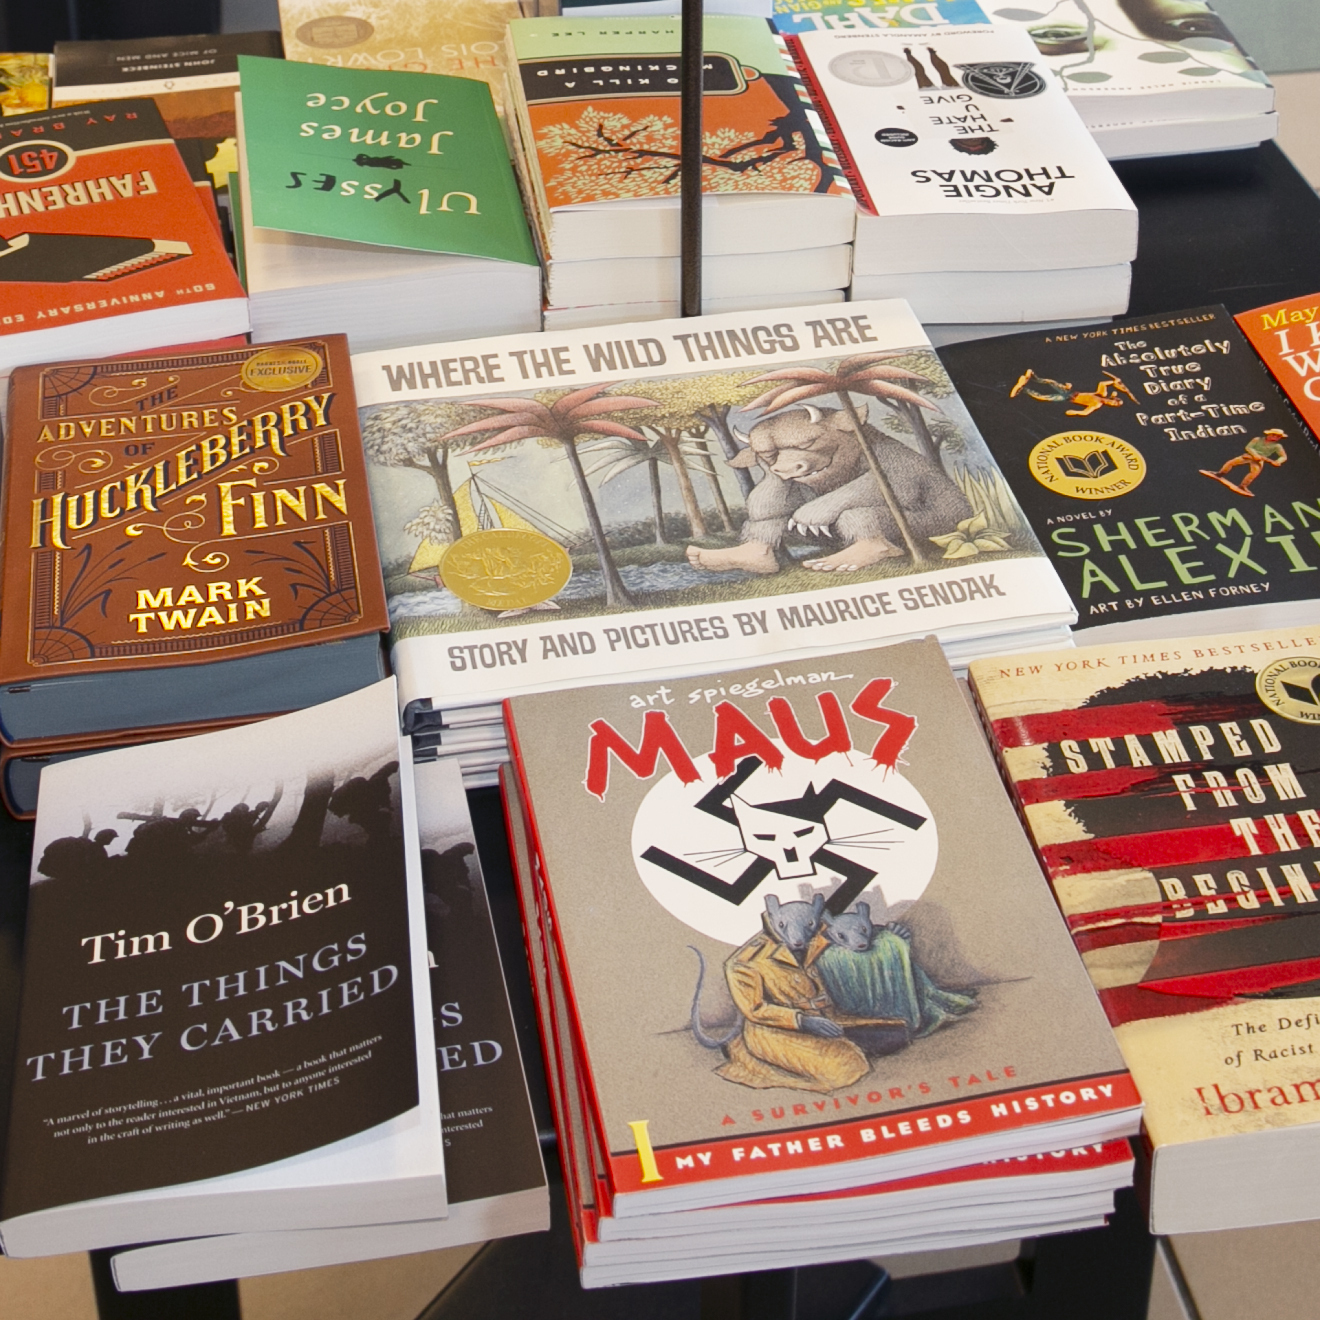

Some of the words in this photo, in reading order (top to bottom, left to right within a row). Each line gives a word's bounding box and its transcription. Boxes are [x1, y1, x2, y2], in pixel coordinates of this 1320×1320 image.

[792, 3, 950, 31] DAHL
[599, 29, 675, 37] HARPER
[122, 62, 181, 73] STEINBECK
[592, 78, 650, 87] KILL
[305, 91, 439, 122] Joyce
[920, 93, 973, 105] GIVE
[85, 111, 138, 126] RAY
[929, 113, 988, 126] HATE
[953, 123, 1000, 135] THE
[299, 122, 454, 155] James
[7, 149, 59, 175] 451
[910, 165, 1076, 184] THOMAS
[939, 181, 1056, 199] ANGIE
[36, 290, 165, 320] ANNIVERSARY
[1055, 332, 1079, 343] NEW
[1082, 327, 1109, 339] YORK
[1111, 323, 1147, 336] TIMES
[1149, 312, 1218, 331] BESTSELLER
[381, 354, 505, 393] WHERE
[509, 346, 578, 381] THE
[583, 336, 669, 375] WILD
[673, 322, 801, 364] THINGS
[804, 313, 879, 347] ARE
[1100, 338, 1232, 369] Absolutely
[1114, 339, 1148, 352] The
[249, 364, 313, 377] EXCLUSIVE
[1139, 360, 1202, 379] True
[134, 384, 179, 413] THE
[1142, 375, 1213, 396] Diary
[37, 405, 239, 445] ADVENTURES
[1136, 400, 1267, 428] Part-Time
[1164, 422, 1248, 443] Indian
[124, 442, 155, 457] OF
[29, 391, 337, 550] HUCKLEBERRY
[217, 478, 348, 537] FINN
[135, 576, 267, 611] MARK
[1088, 599, 1122, 616] ART
[1124, 597, 1145, 610] BY
[1150, 590, 1204, 608] ELLEN
[1207, 581, 1272, 599] FORNEY
[129, 598, 272, 634] TWAIN
[447, 634, 530, 672] STORY
[540, 626, 598, 660] AND
[601, 614, 730, 655] PICTURES
[733, 610, 770, 637] BY
[778, 591, 900, 631] MAURICE
[901, 573, 1007, 613] SENDAK
[629, 683, 676, 711] art
[686, 668, 855, 706] spiegelman
[583, 677, 918, 802] MAUS
[1060, 718, 1283, 775] STAMPED
[1172, 762, 1307, 811] FROM
[81, 927, 173, 965] Tim
[185, 881, 353, 946] O'Brien
[62, 989, 164, 1030] THE
[181, 932, 370, 1008] THINGS
[26, 1031, 164, 1082] THEY
[179, 962, 400, 1053] CARRIED
[1231, 1020, 1269, 1039] The
[1252, 1042, 1317, 1065] Racist
[245, 1100, 272, 1113] NEW
[274, 1089, 304, 1104] YORK
[307, 1076, 341, 1094] TIMES
[751, 1080, 932, 1123] SURVIVOR'S
[948, 1064, 1018, 1089] TALE
[675, 1150, 713, 1172] MY
[732, 1133, 845, 1163] FATHER
[860, 1108, 973, 1145] BLEEDS
[990, 1083, 1117, 1118] HISTORY
